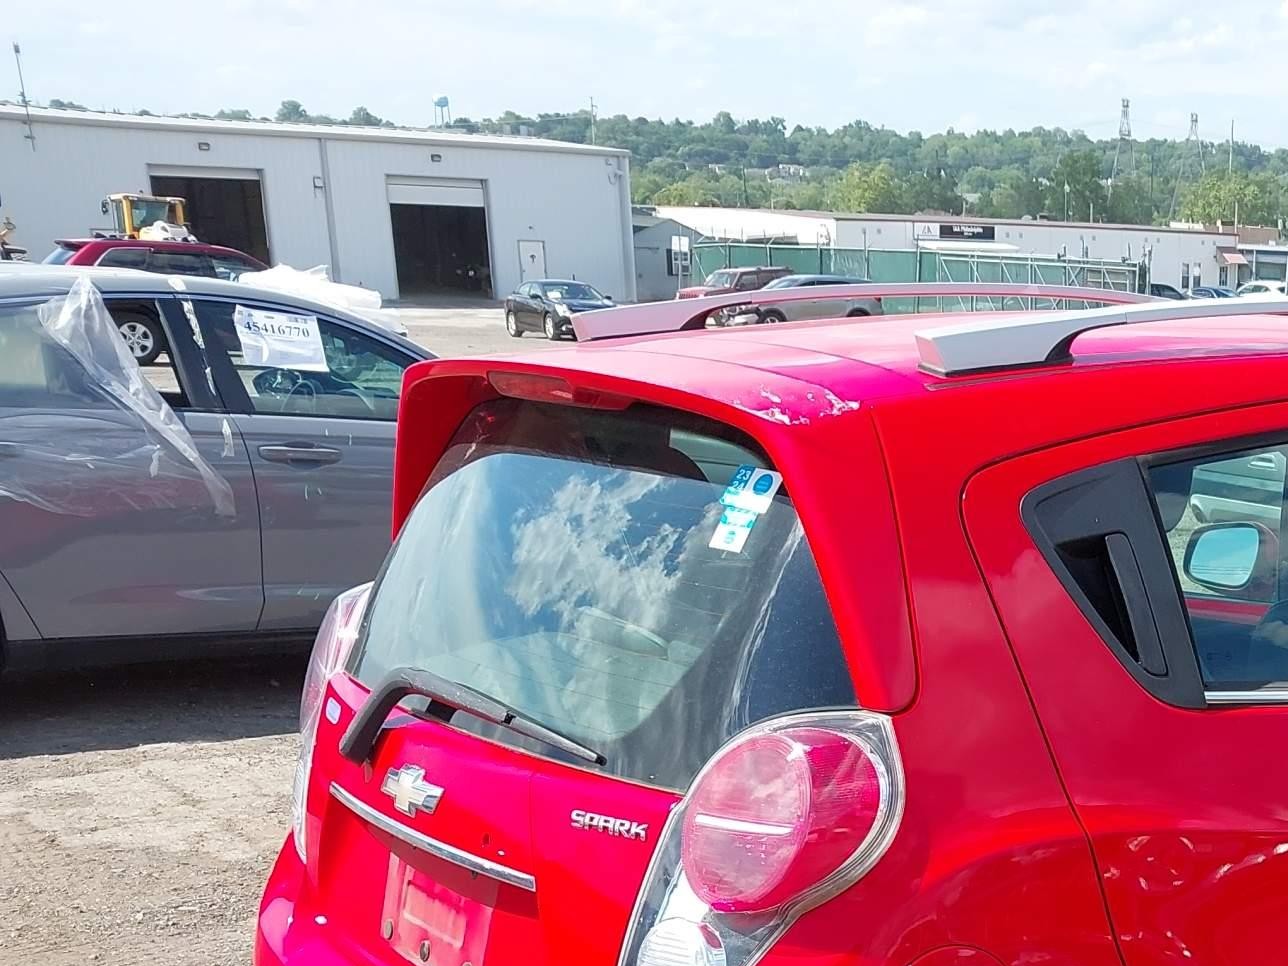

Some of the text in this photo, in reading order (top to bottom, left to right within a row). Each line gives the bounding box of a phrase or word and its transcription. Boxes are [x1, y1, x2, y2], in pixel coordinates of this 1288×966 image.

[244, 321, 310, 338] 45416770
[736, 469, 752, 481] 23
[570, 809, 649, 842] SPARK
